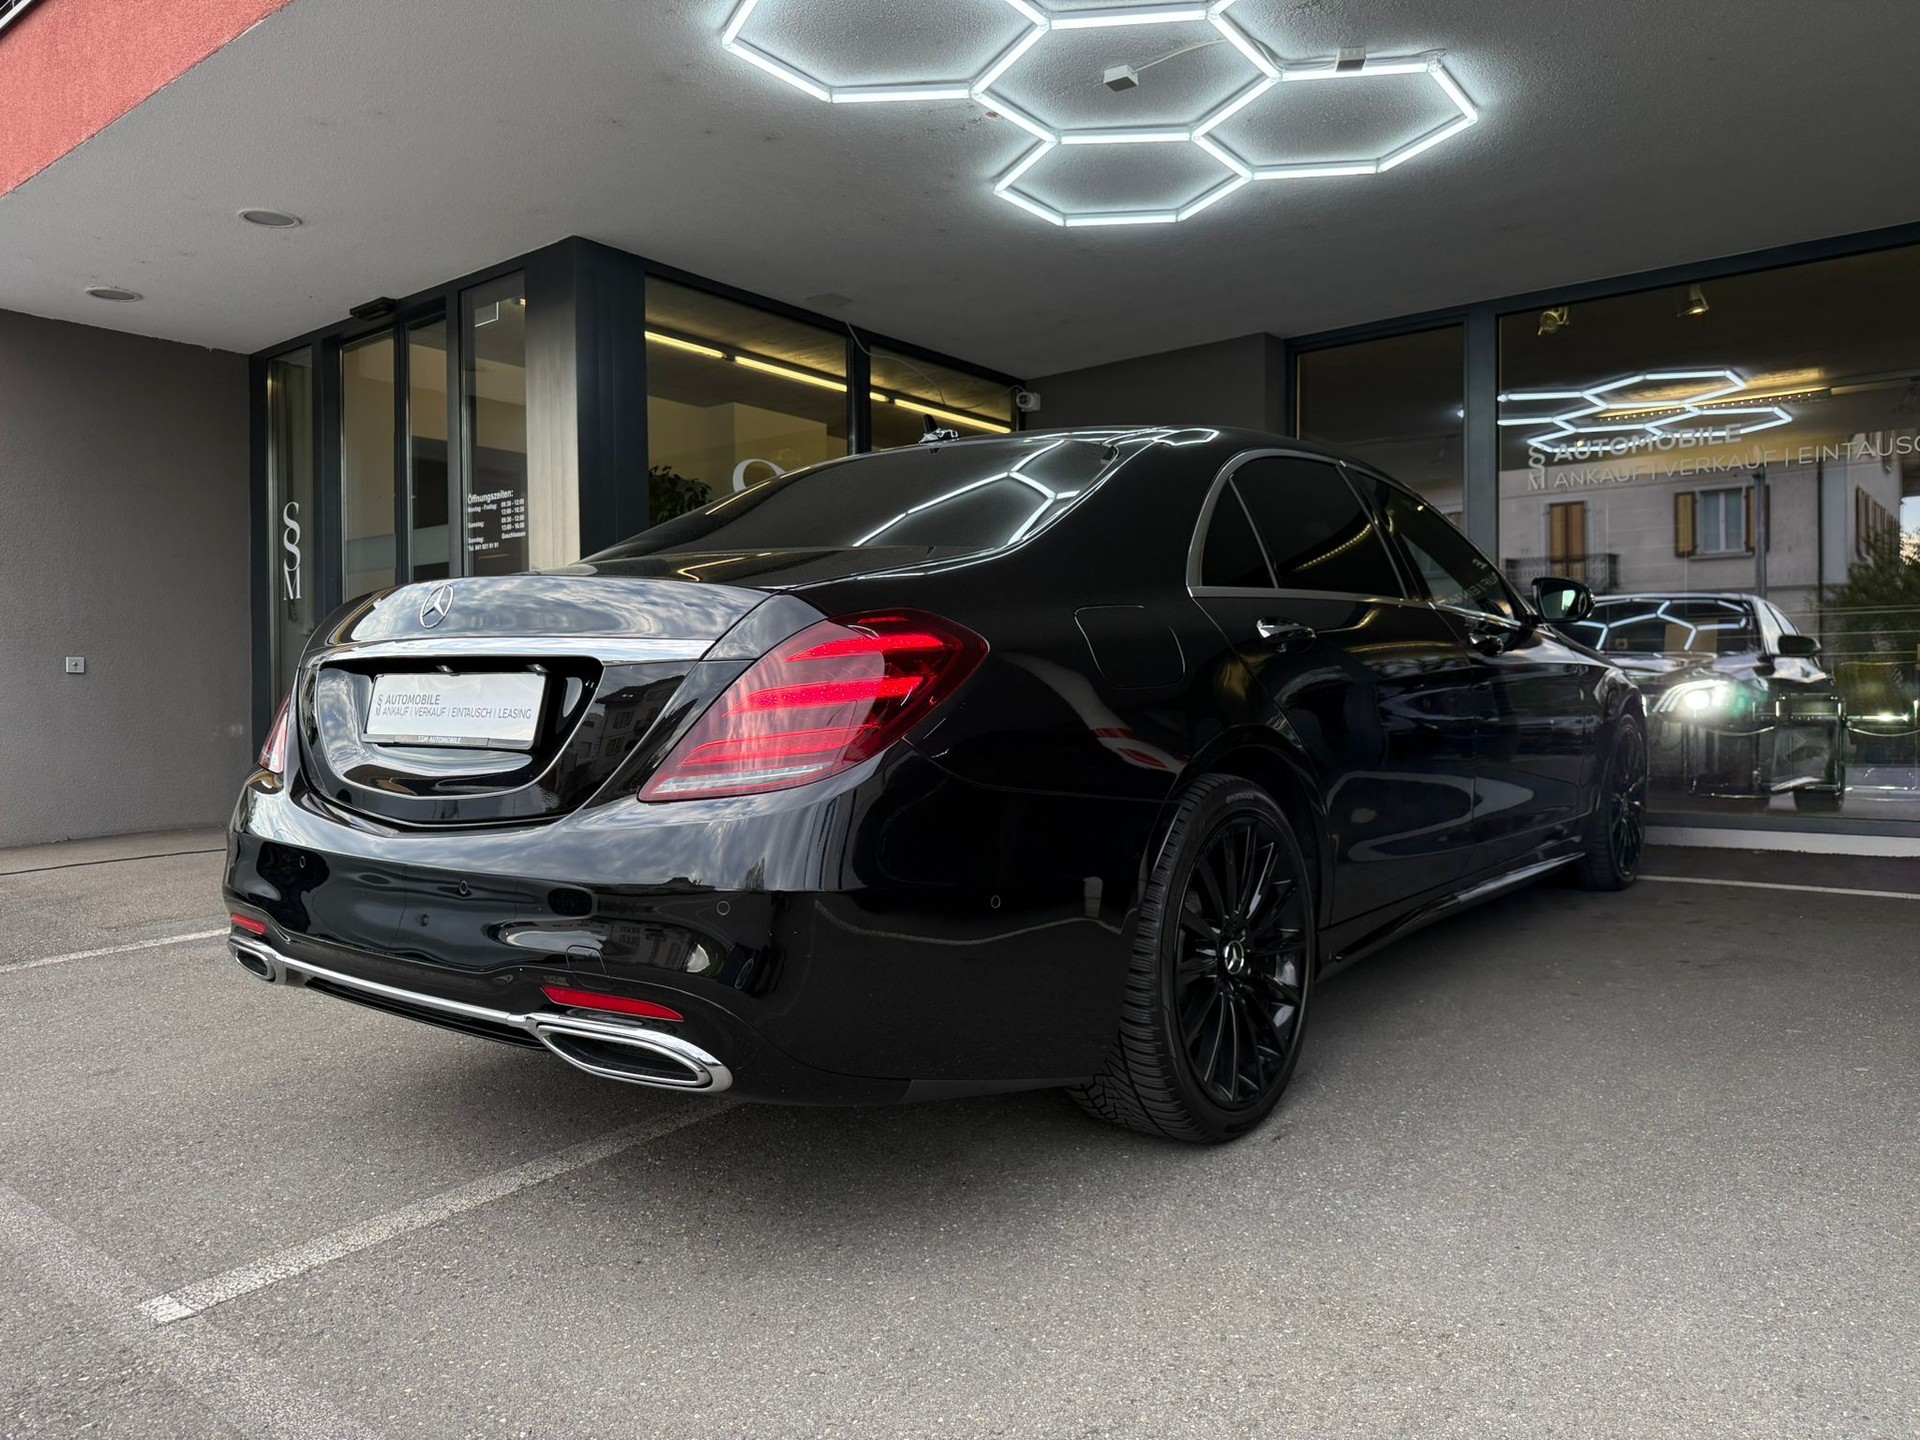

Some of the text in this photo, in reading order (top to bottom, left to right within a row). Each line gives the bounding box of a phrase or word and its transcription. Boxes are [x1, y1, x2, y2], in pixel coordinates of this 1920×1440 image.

[1553, 424, 1742, 463] AUTOMOBILE
[1554, 464, 1643, 488] ANKAUF
[1664, 450, 1777, 478] VERKAUF
[468, 490, 514, 504] Öffnungszeiten:
[384, 694, 441, 705] AUTOMOBILE
[382, 706, 409, 717] ANKAUF
[413, 707, 447, 718] VERKAUF
[451, 707, 492, 718] EINTAUSCH
[497, 708, 532, 719] LEASING
[430, 736, 462, 744] AUTOMOBILE
